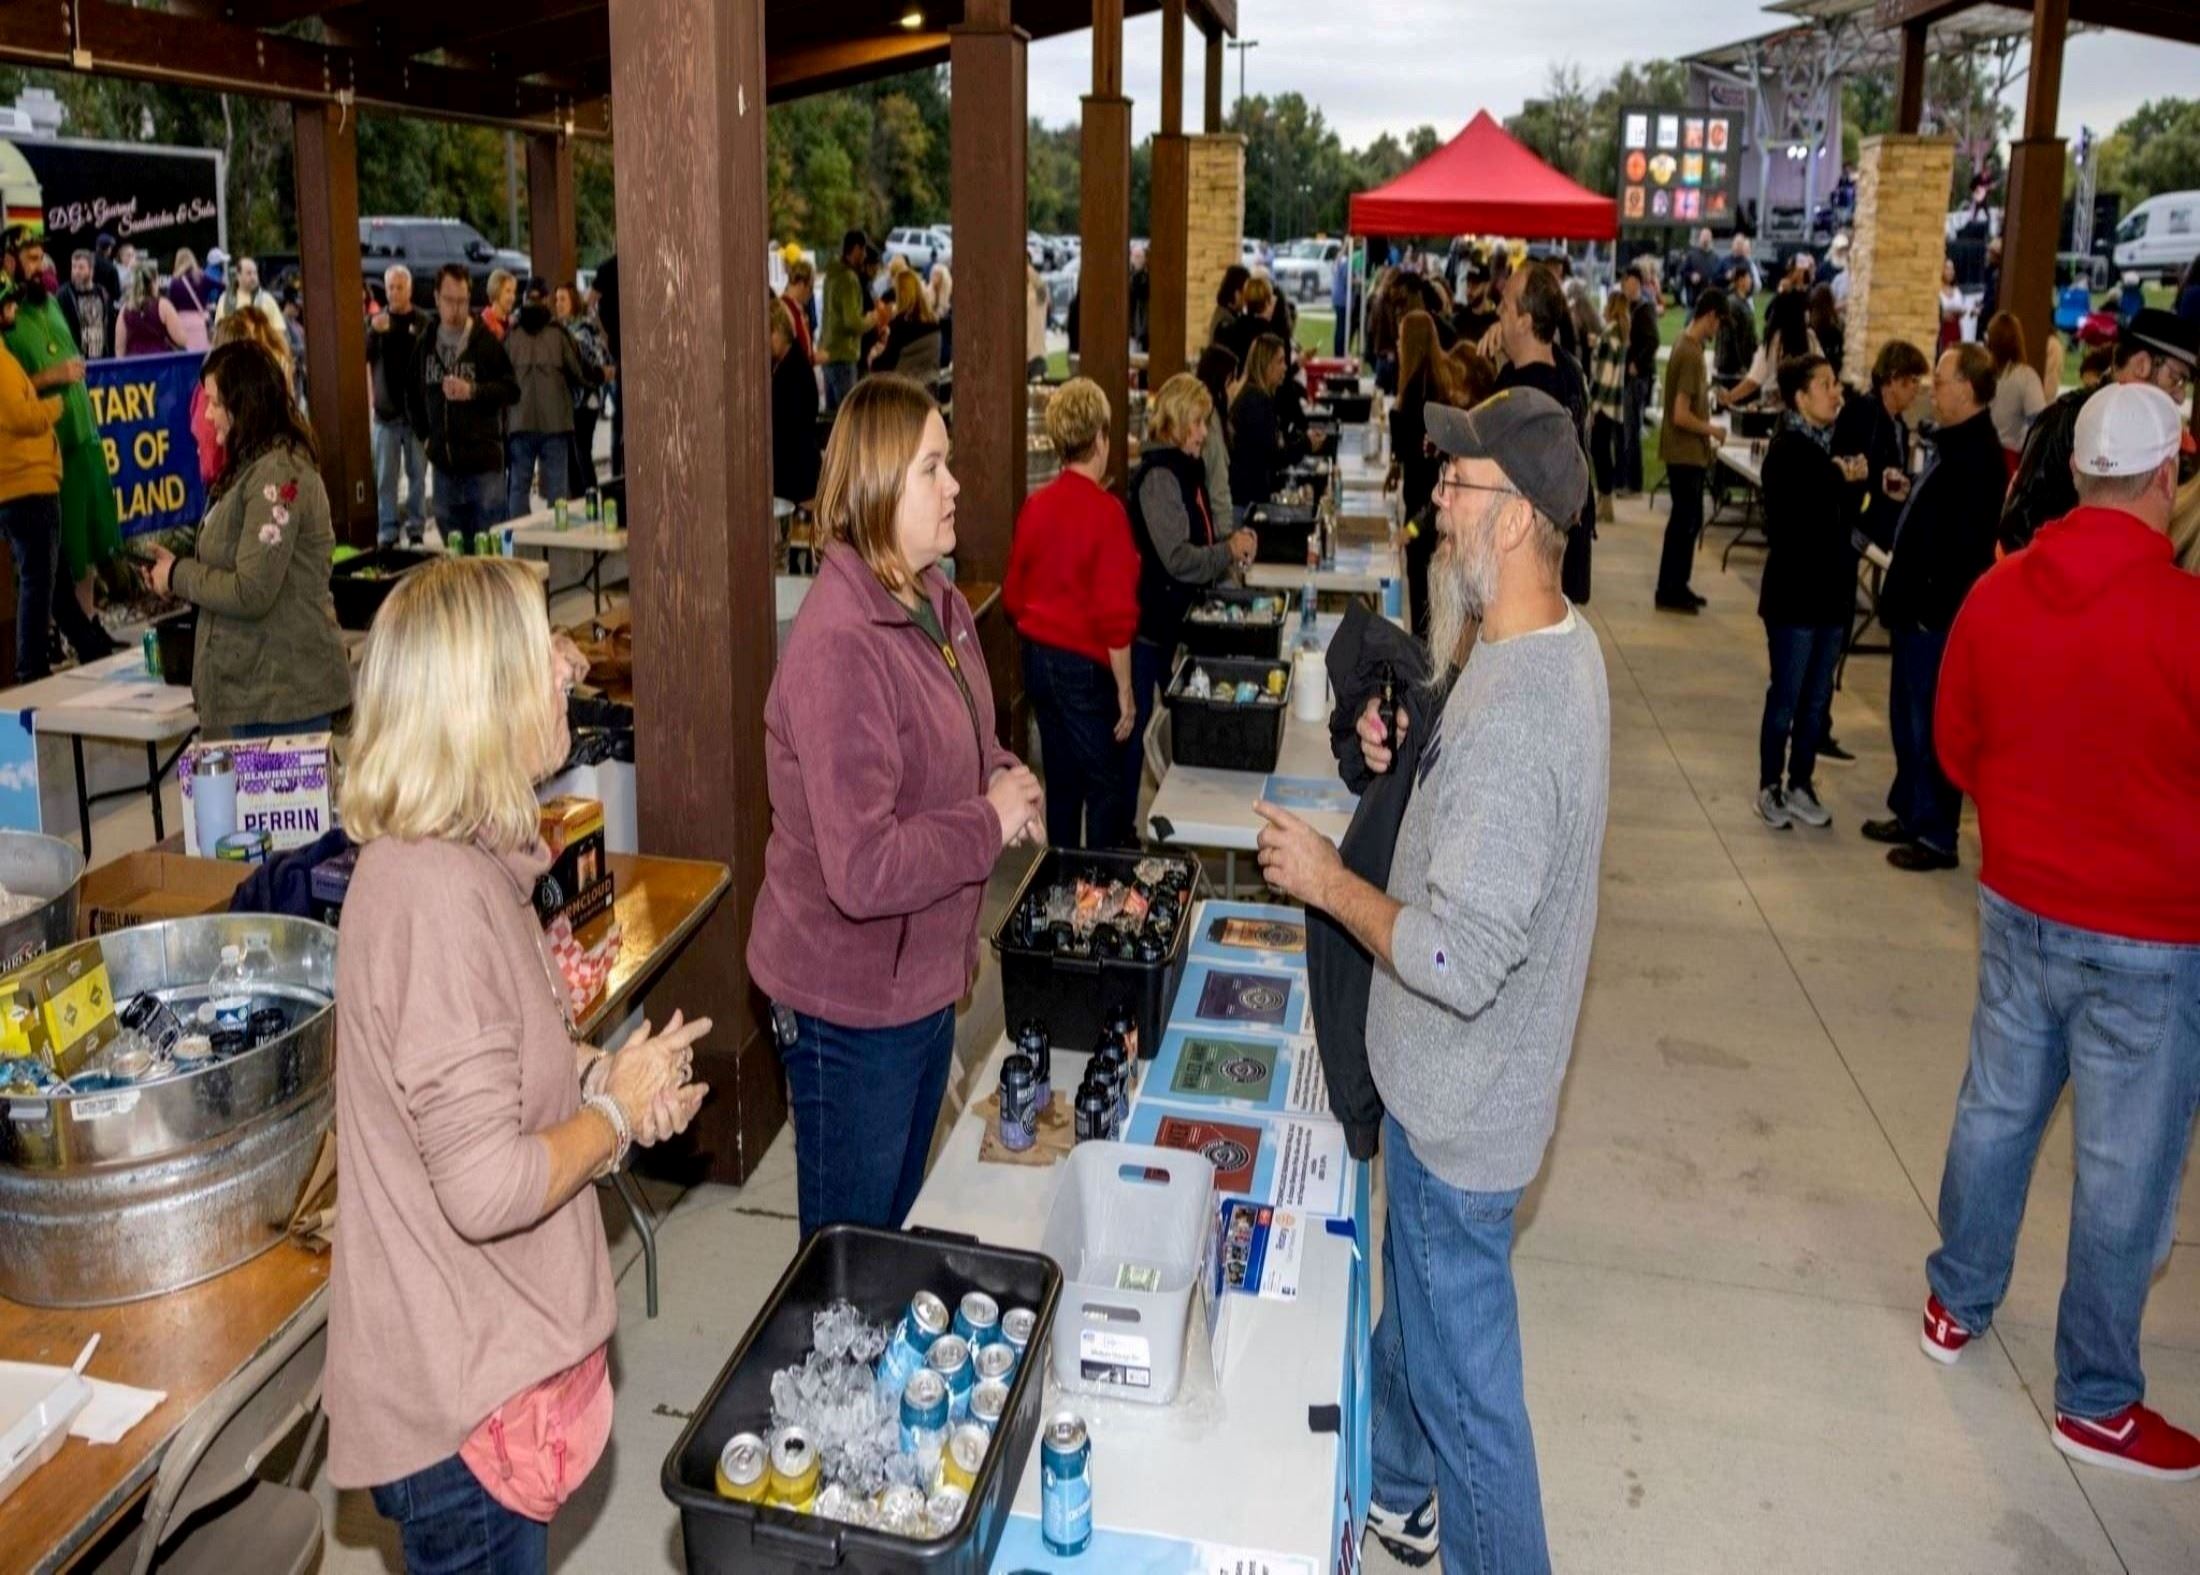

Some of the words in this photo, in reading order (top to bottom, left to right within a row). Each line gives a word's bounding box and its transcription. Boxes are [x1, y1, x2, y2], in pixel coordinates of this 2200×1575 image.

[176, 203, 188, 224] &
[88, 381, 157, 426] TARY
[133, 429, 169, 470] OF
[115, 473, 186, 524] LAND
[244, 806, 319, 832] PERRIN
[100, 910, 116, 928] BIG
